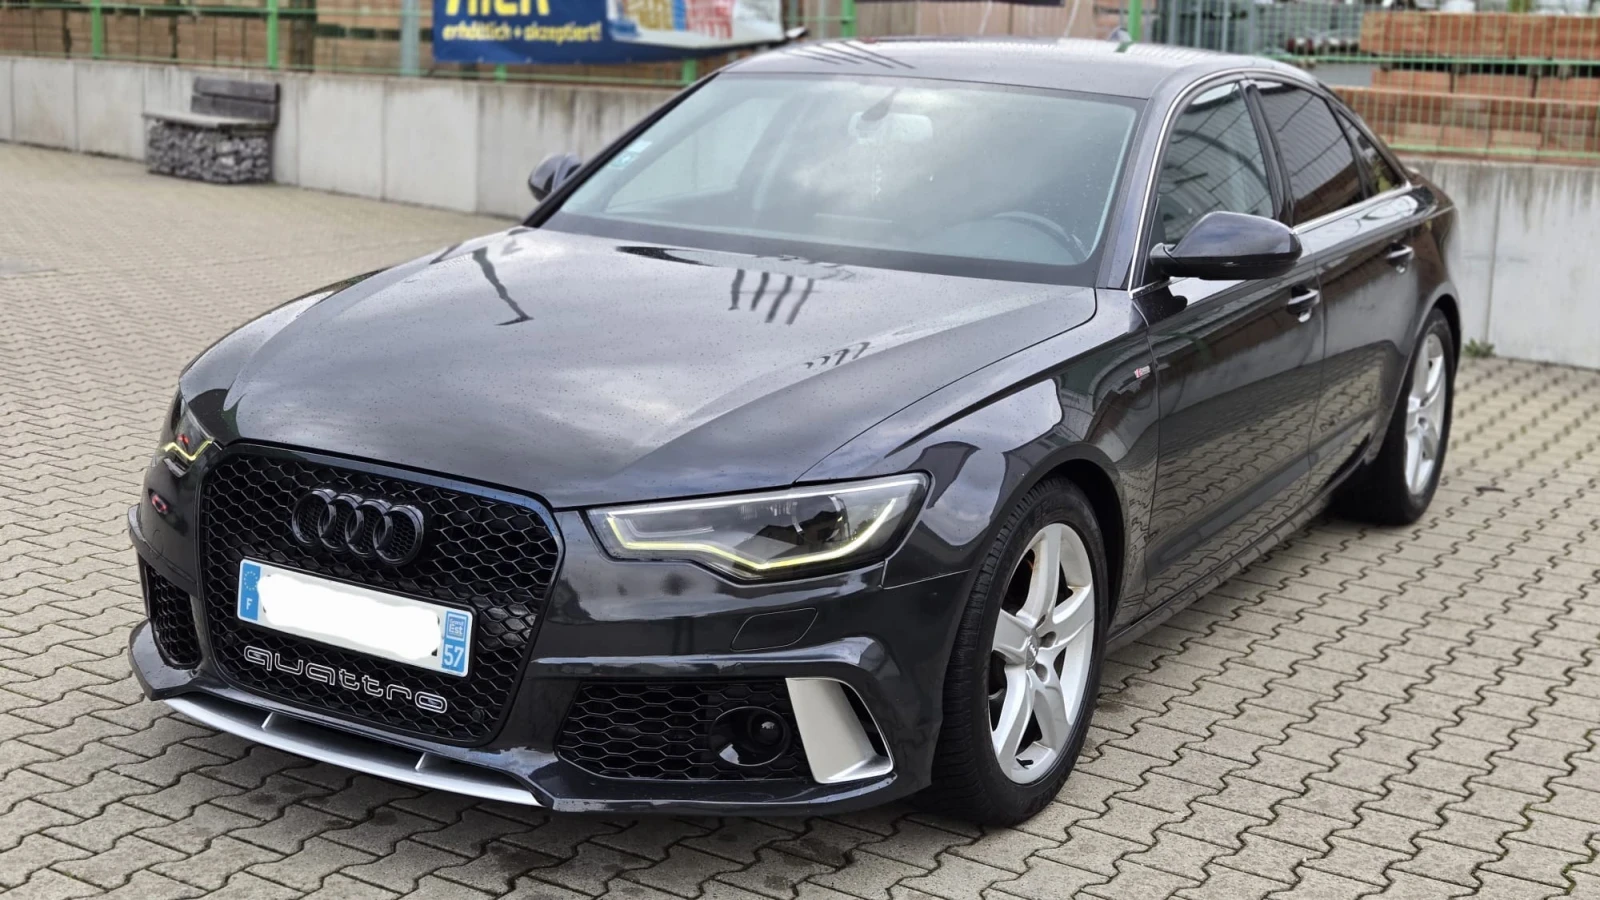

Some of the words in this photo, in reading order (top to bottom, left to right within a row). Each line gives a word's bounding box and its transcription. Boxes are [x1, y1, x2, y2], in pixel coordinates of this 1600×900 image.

[442, 21, 512, 41] erhältlich
[245, 597, 253, 610] F
[448, 623, 464, 636] Est
[444, 643, 465, 668] 57
[244, 646, 447, 714] quattro
